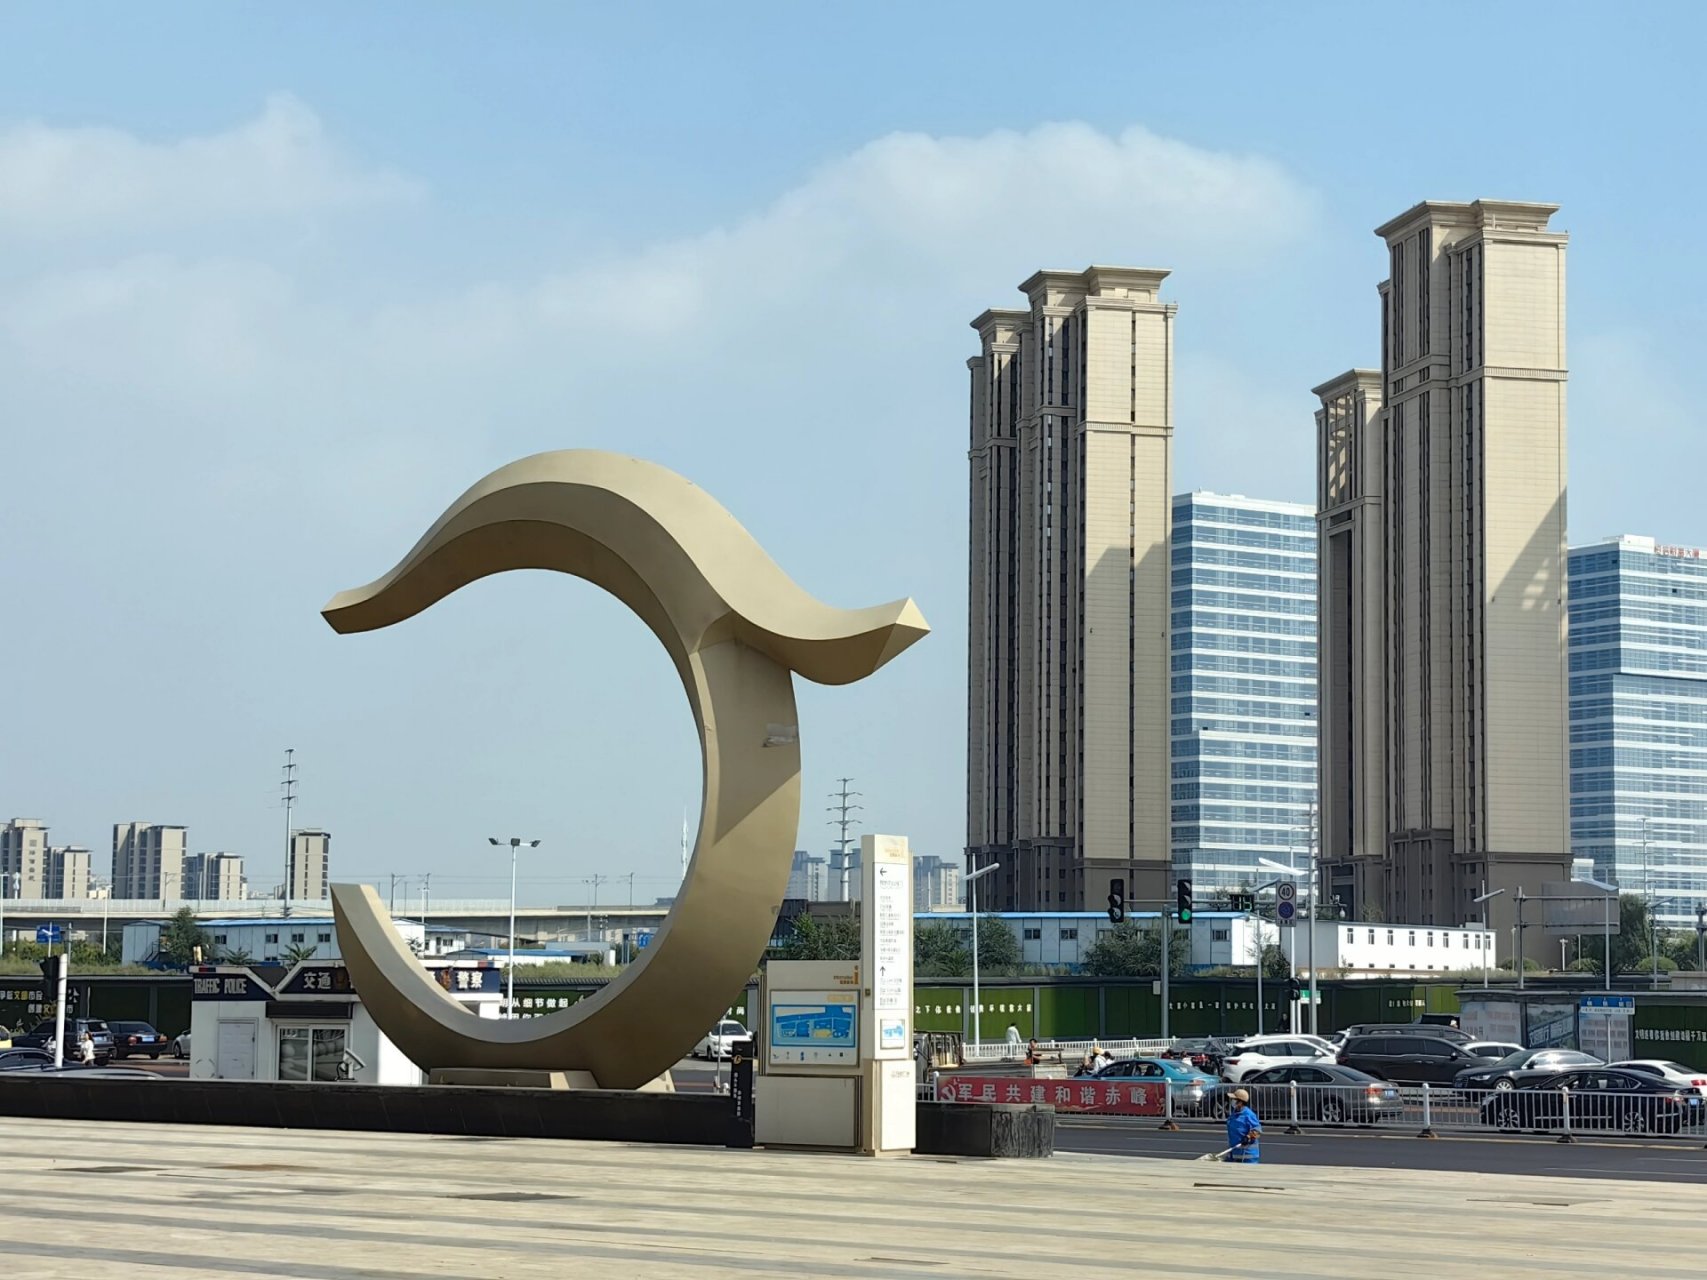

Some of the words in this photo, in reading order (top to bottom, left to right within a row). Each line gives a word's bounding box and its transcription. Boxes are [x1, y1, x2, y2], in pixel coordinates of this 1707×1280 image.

[1281, 887, 1291, 897] 40
[194, 977, 220, 994] TRAFFIC
[224, 977, 247, 994] POLICE
[303, 971, 331, 990] 交通
[456, 970, 483, 989] 警察
[958, 1083, 1147, 1106] 军民共建和谐赤峰
